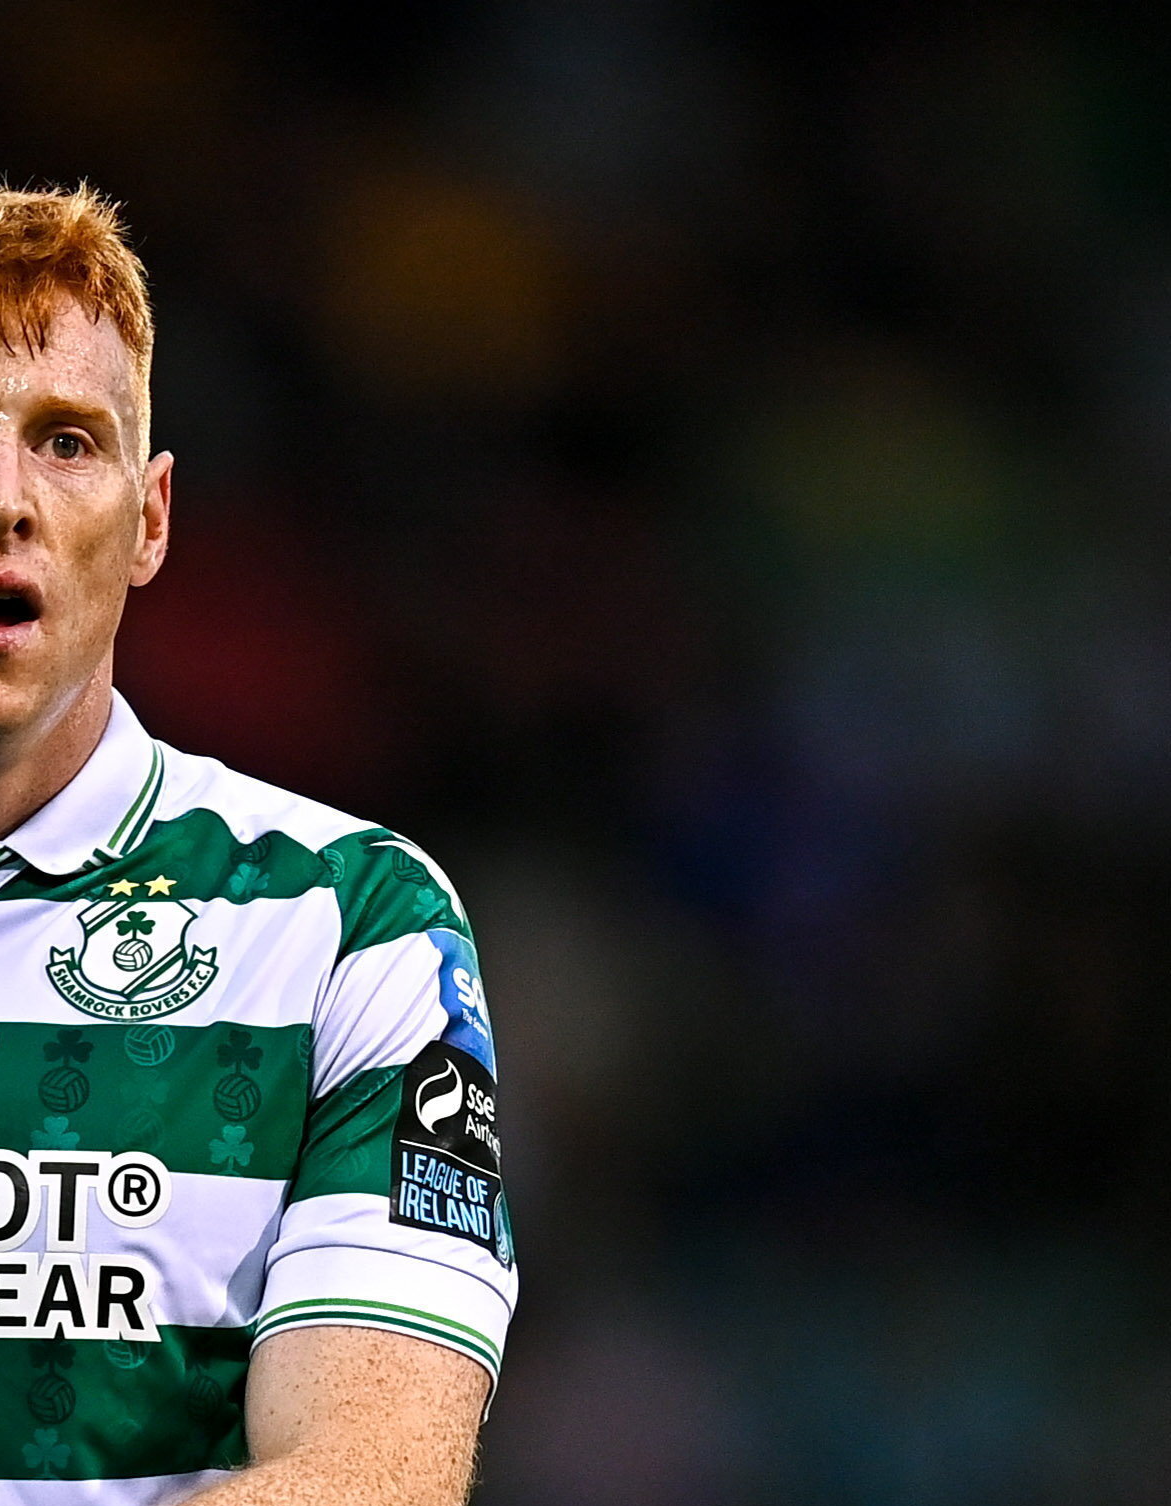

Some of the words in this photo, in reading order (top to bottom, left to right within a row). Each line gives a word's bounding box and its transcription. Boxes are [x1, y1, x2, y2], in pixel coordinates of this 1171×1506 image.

[53, 968, 125, 1017] SHAMROCK
[129, 988, 191, 1018] ROVERS
[190, 969, 212, 991] F.C.
[466, 1083, 495, 1122] sse
[402, 1151, 463, 1200] LEAGUE
[466, 1175, 488, 1205] OF
[398, 1180, 490, 1241] IRELAND
